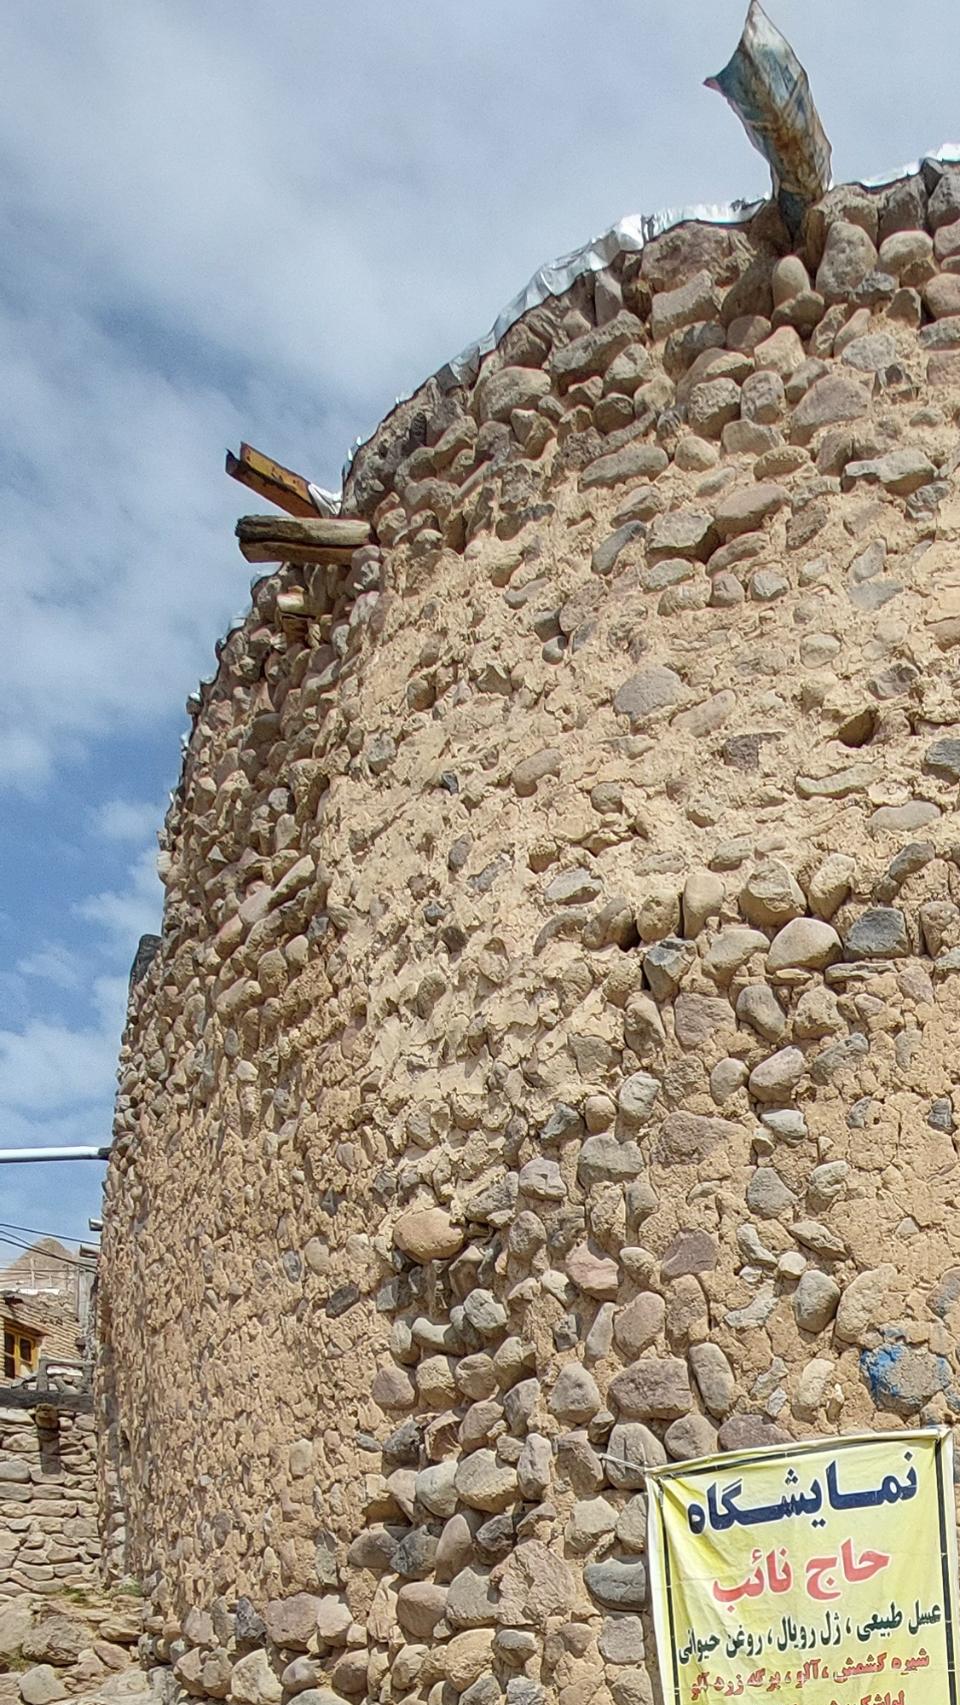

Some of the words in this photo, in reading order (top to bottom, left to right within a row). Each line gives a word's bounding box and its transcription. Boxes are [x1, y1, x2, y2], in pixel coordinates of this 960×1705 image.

[687, 1451, 918, 1535] نمایشگاه
[712, 1547, 793, 1613] نائب
[805, 1538, 891, 1600] حاج
[820, 1610, 841, 1646] ژل
[908, 1600, 942, 1634] عسل
[678, 1627, 721, 1665] حیوانی
[726, 1625, 763, 1659] روغن
[889, 1647, 930, 1676] شیره
[747, 1668, 782, 1692] برگه
